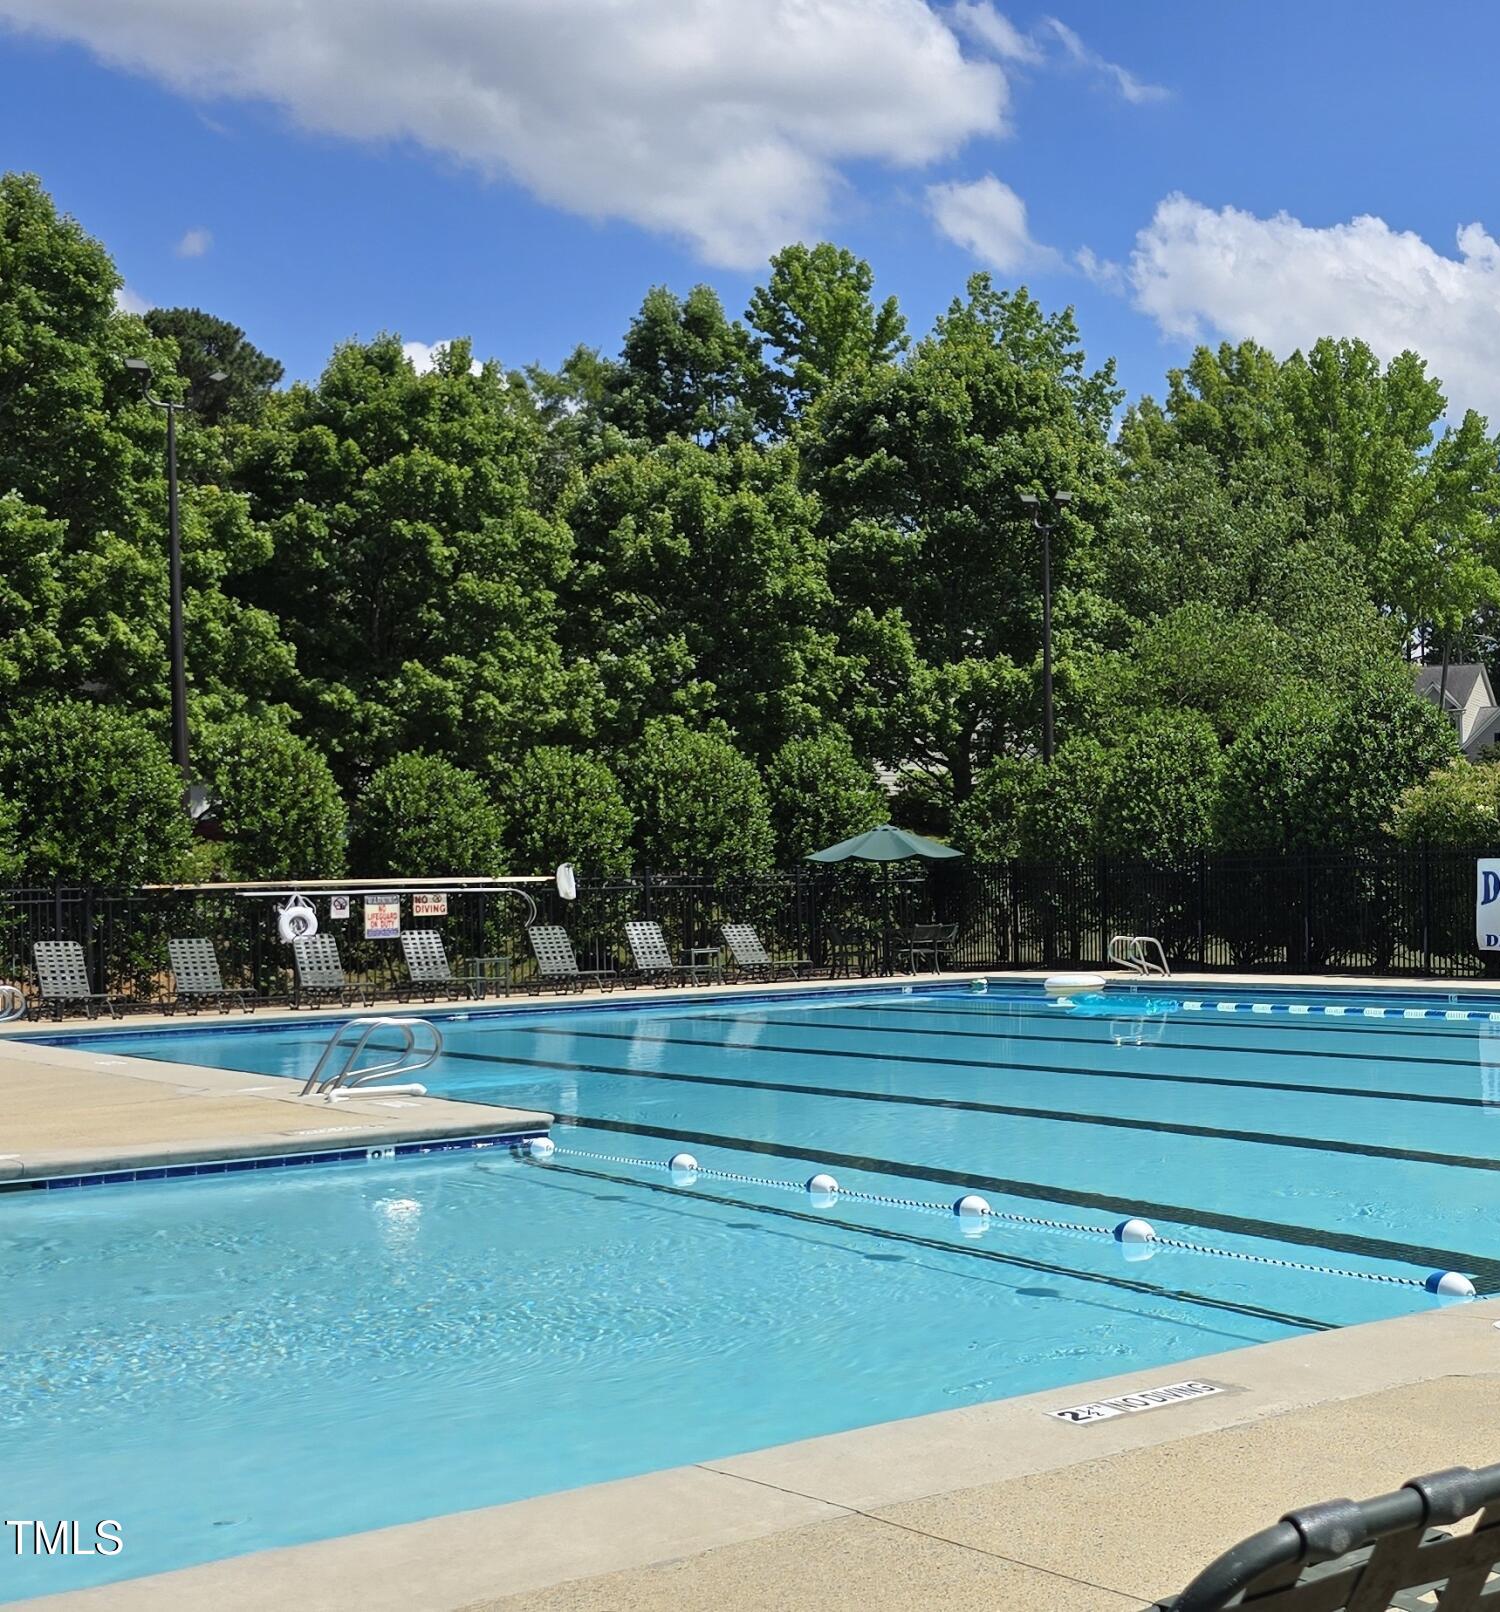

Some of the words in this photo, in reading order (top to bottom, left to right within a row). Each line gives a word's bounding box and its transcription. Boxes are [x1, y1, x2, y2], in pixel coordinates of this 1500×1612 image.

[415, 896, 427, 904] NO
[415, 904, 446, 913] DIVING
[1142, 1383, 1217, 1402] DIVING
